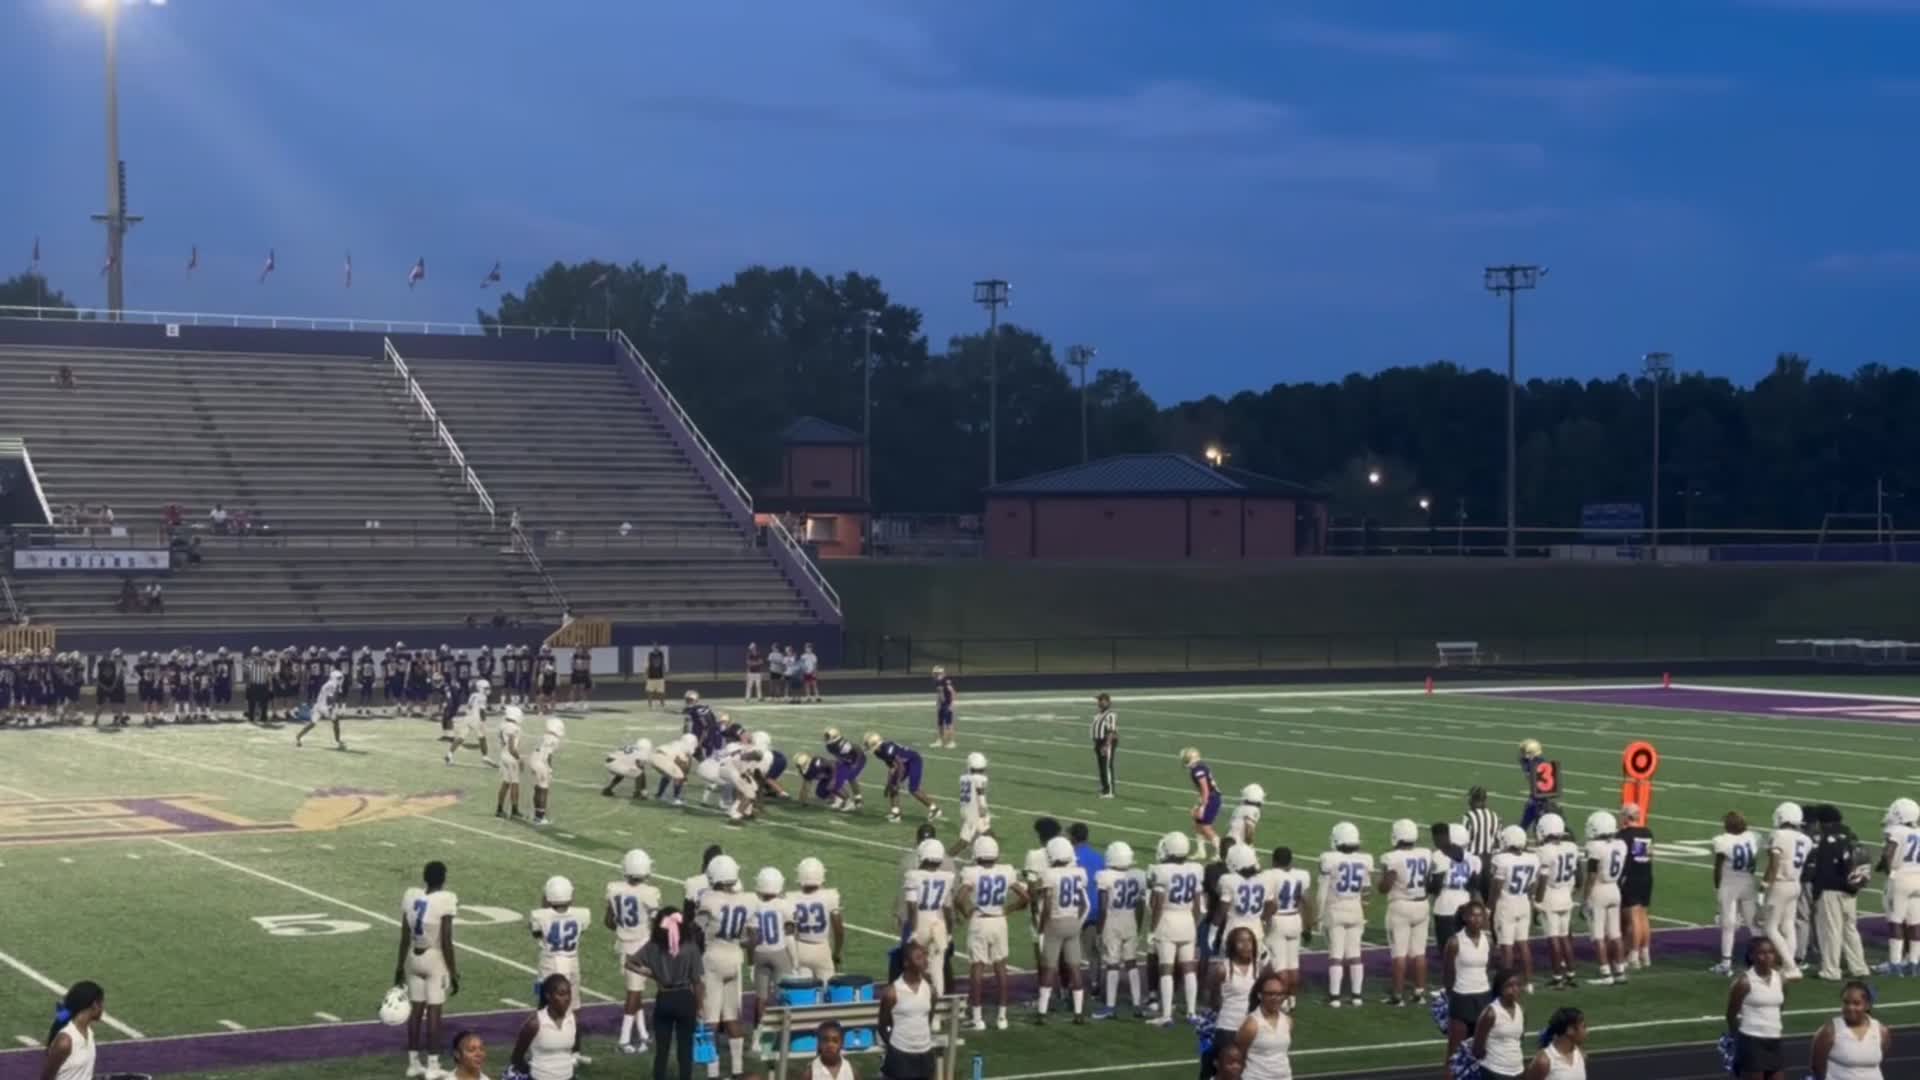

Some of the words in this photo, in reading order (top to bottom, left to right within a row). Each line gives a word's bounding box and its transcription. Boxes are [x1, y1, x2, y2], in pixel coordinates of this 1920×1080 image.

[1536, 762, 1555, 791] 3
[1555, 854, 1575, 883] 15
[1609, 850, 1621, 879] 6
[1793, 841, 1805, 868] 5
[1168, 873, 1197, 904] 28
[1336, 862, 1364, 892] 35
[1406, 857, 1428, 889] 79
[919, 880, 946, 911] 17
[977, 875, 1006, 906] 82
[1059, 875, 1083, 908] 85
[1113, 879, 1139, 909] 32
[1235, 882, 1265, 914] 33
[1278, 880, 1302, 910] 44
[413, 899, 428, 936] 7
[614, 895, 639, 928] 13
[716, 904, 747, 939] 10
[795, 902, 827, 933] 23
[547, 919, 578, 952] 42
